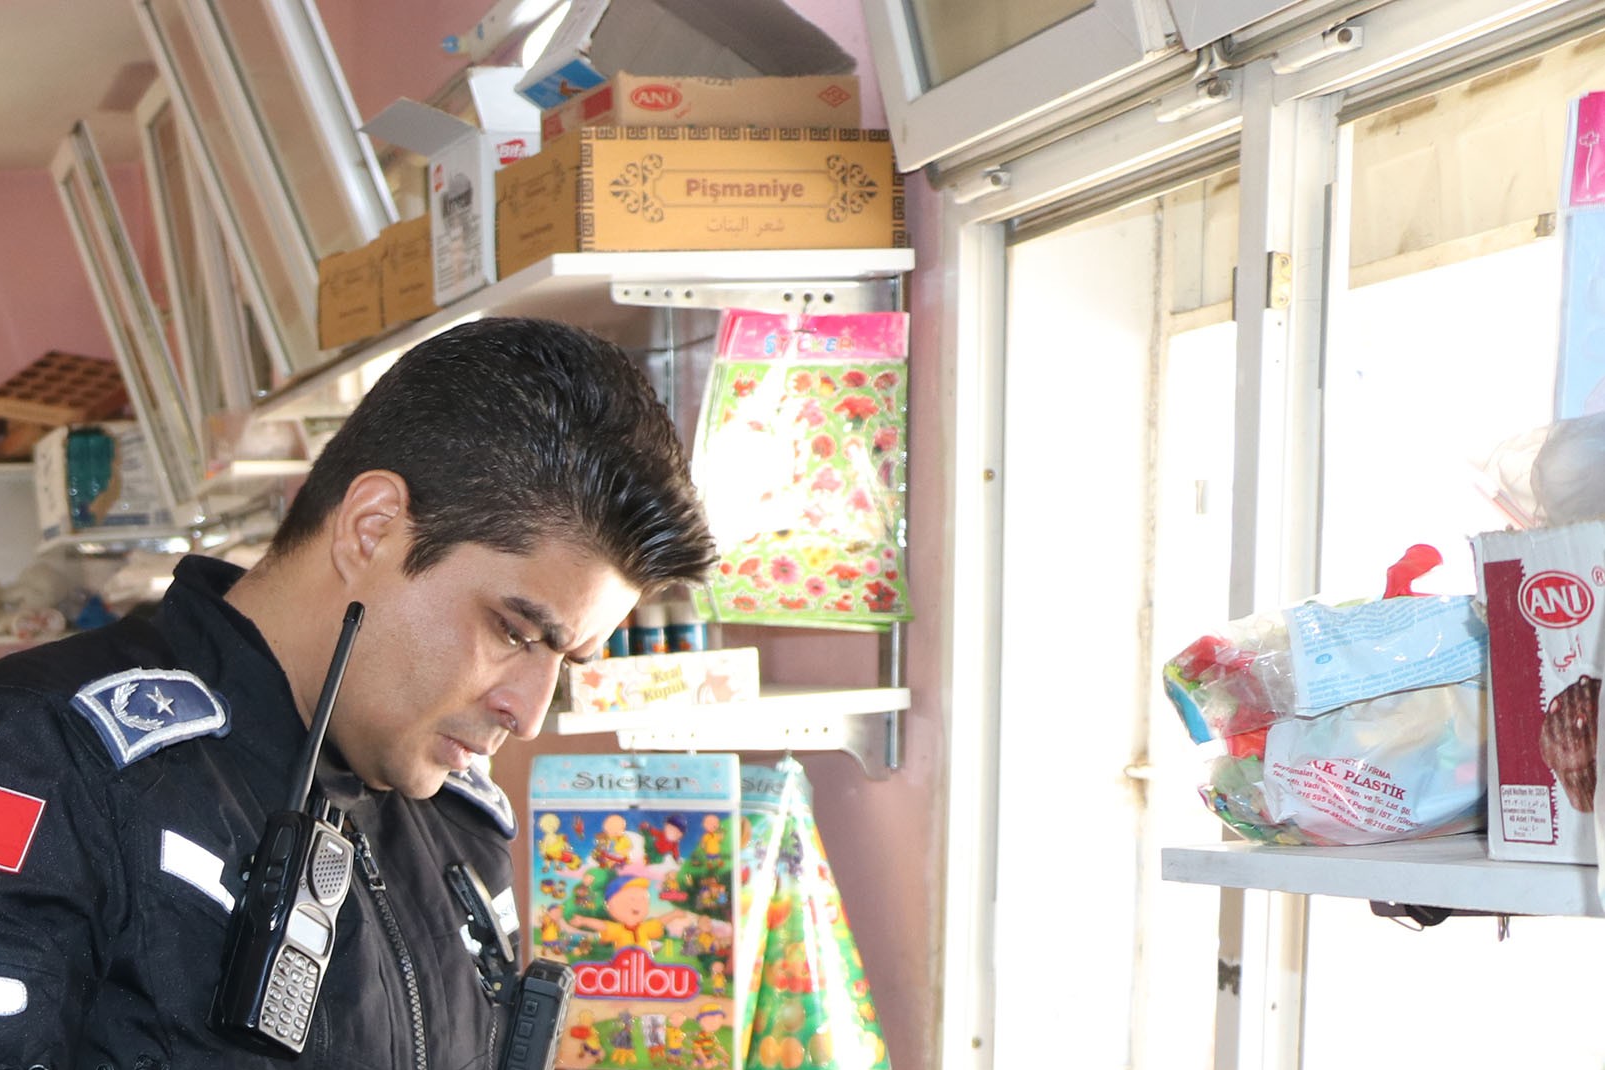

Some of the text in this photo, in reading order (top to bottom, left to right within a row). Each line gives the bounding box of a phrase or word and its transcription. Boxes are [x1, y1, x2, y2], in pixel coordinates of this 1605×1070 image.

[637, 89, 674, 104] ANI
[685, 177, 805, 202] Pişmaniye
[764, 333, 855, 354] STCKER
[1530, 584, 1585, 615] ANI
[571, 771, 692, 792] Sticker
[741, 775, 784, 795] Stic
[1342, 770, 1407, 800] PLASTİK
[575, 953, 691, 996] caillou
